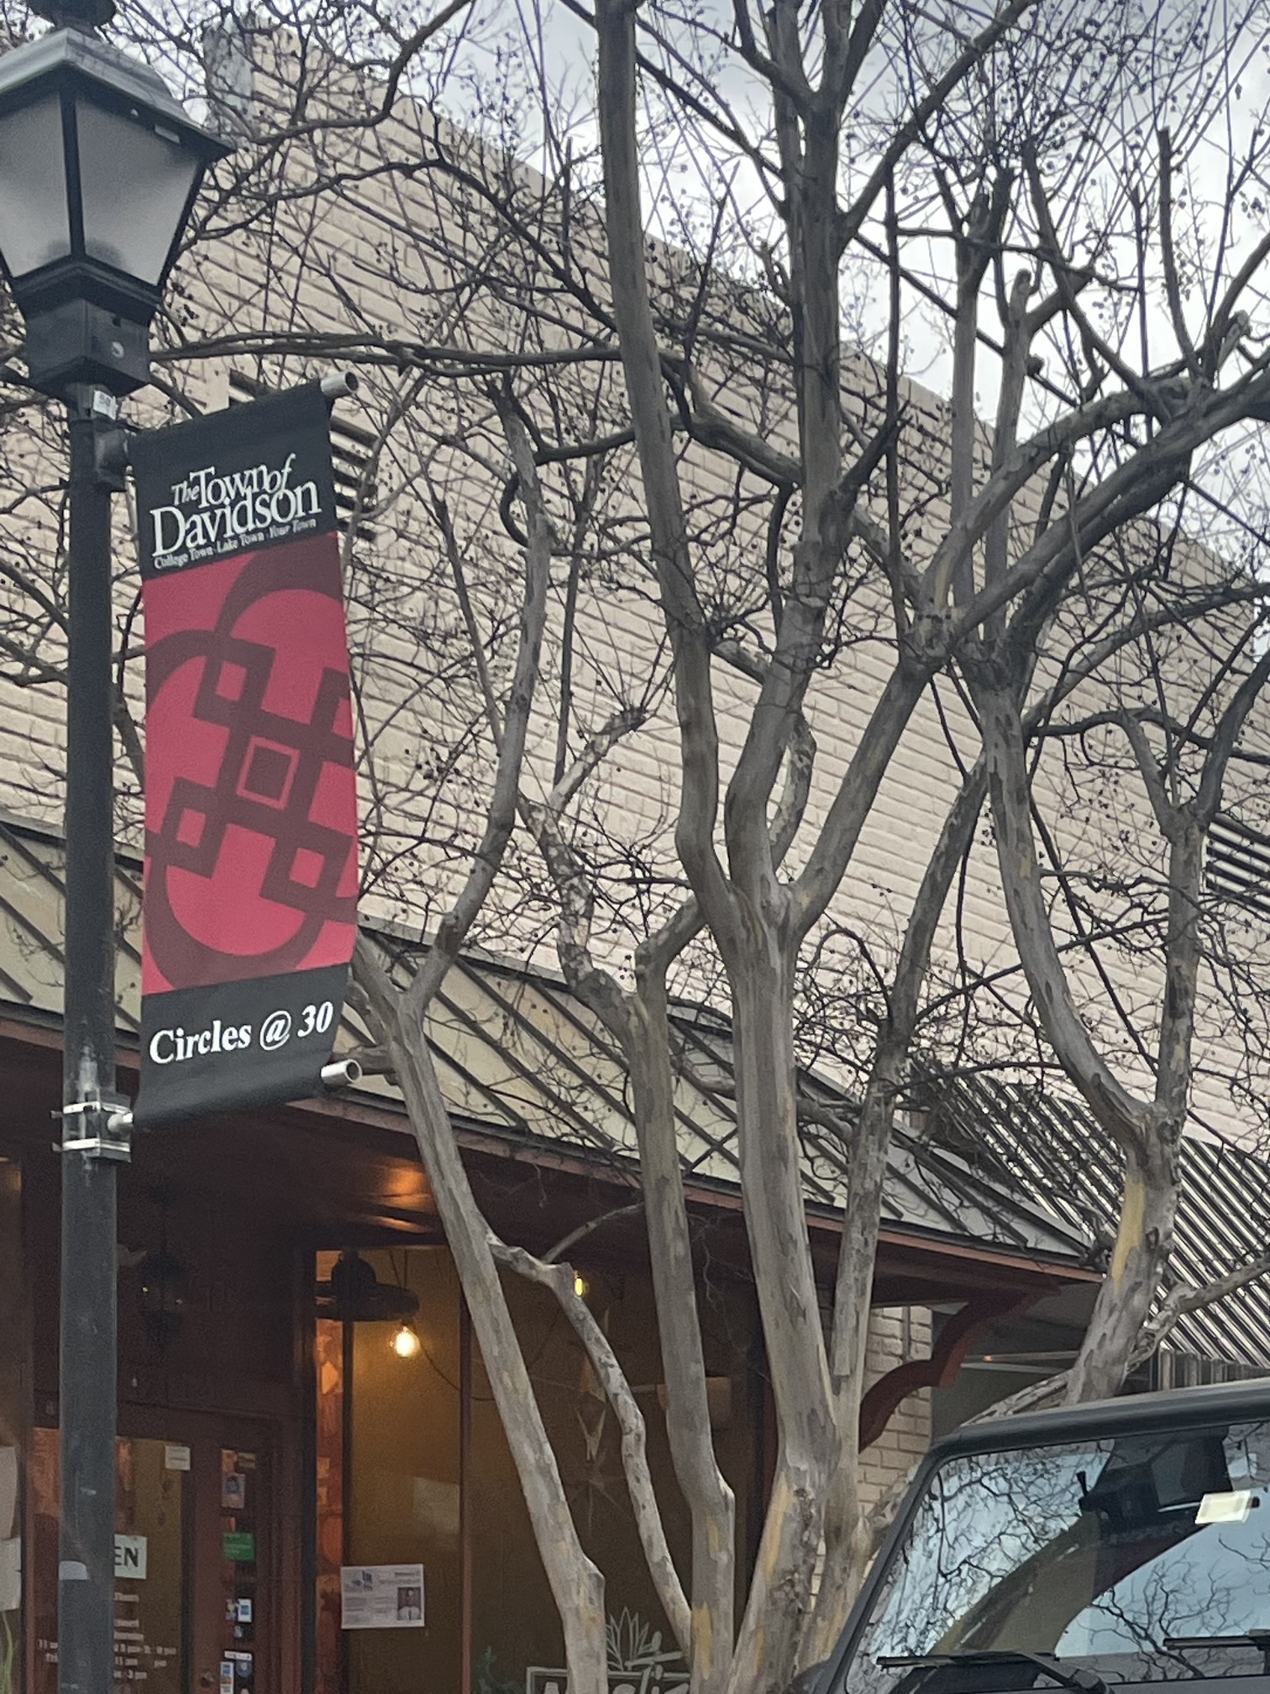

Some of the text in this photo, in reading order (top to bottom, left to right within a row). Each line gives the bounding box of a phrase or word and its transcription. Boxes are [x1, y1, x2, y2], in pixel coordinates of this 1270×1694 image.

[171, 453, 296, 509] The Town of
[150, 481, 322, 557] Davidson
[154, 553, 189, 570] College
[188, 547, 214, 561] Town
[217, 538, 239, 553] Lake
[239, 532, 265, 547] Town
[292, 519, 317, 533] Town
[150, 1001, 334, 1064] Circles @ 30
